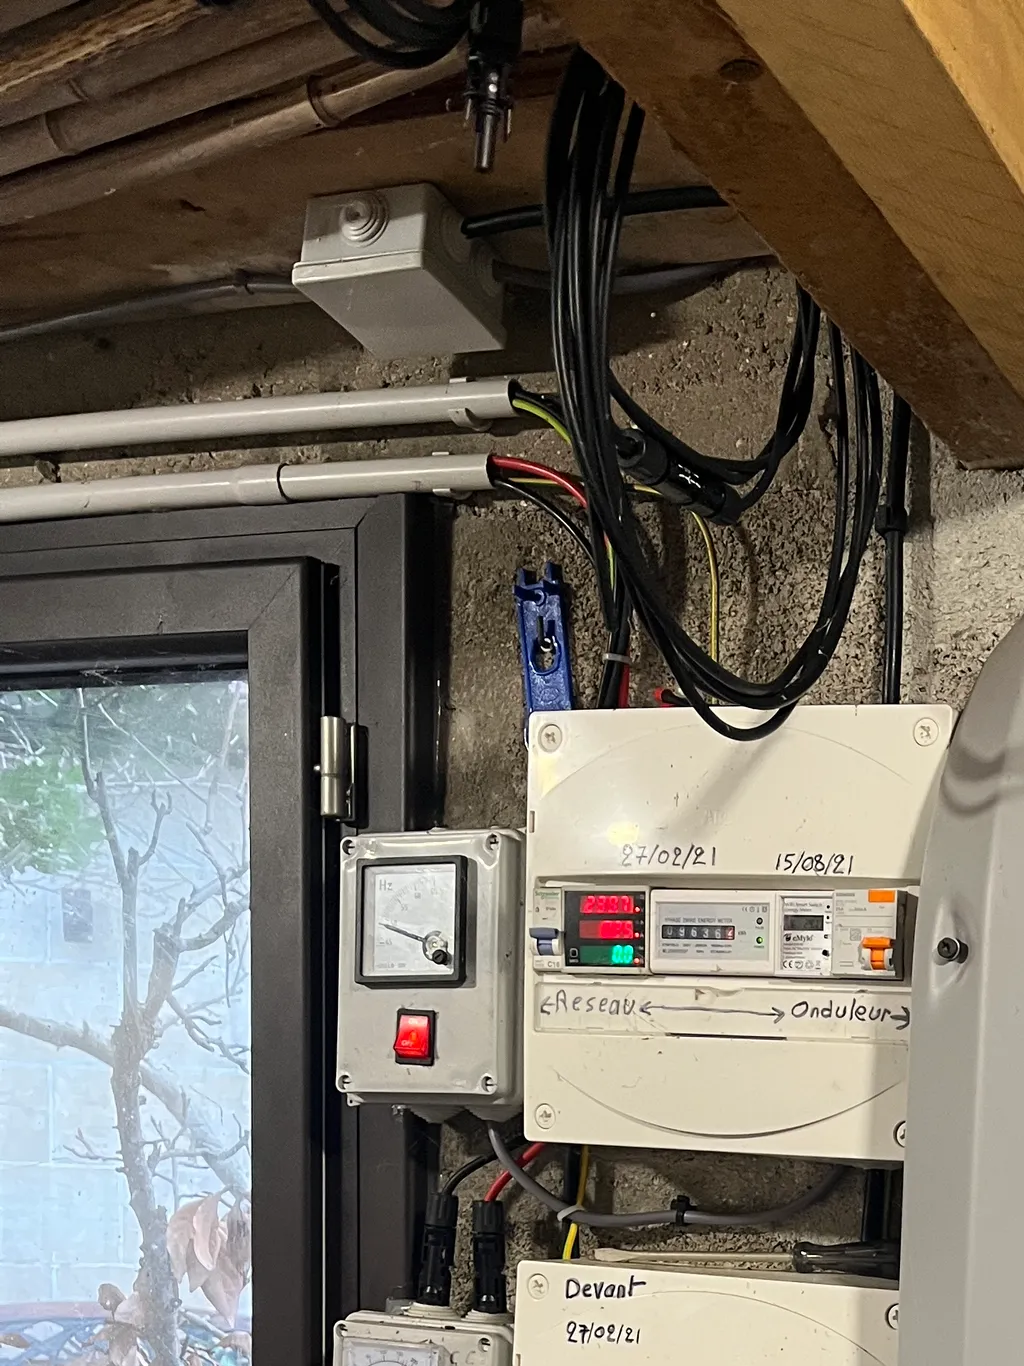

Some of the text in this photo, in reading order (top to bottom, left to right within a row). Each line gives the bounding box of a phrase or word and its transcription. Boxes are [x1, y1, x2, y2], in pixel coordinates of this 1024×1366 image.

[621, 844, 716, 869] 27/02/21
[776, 851, 853, 875] 15/08/21
[379, 880, 393, 891] Hz
[791, 998, 891, 1021] Onduleur
[565, 1276, 646, 1299] Devant
[566, 1321, 640, 1345] 27/02/21
